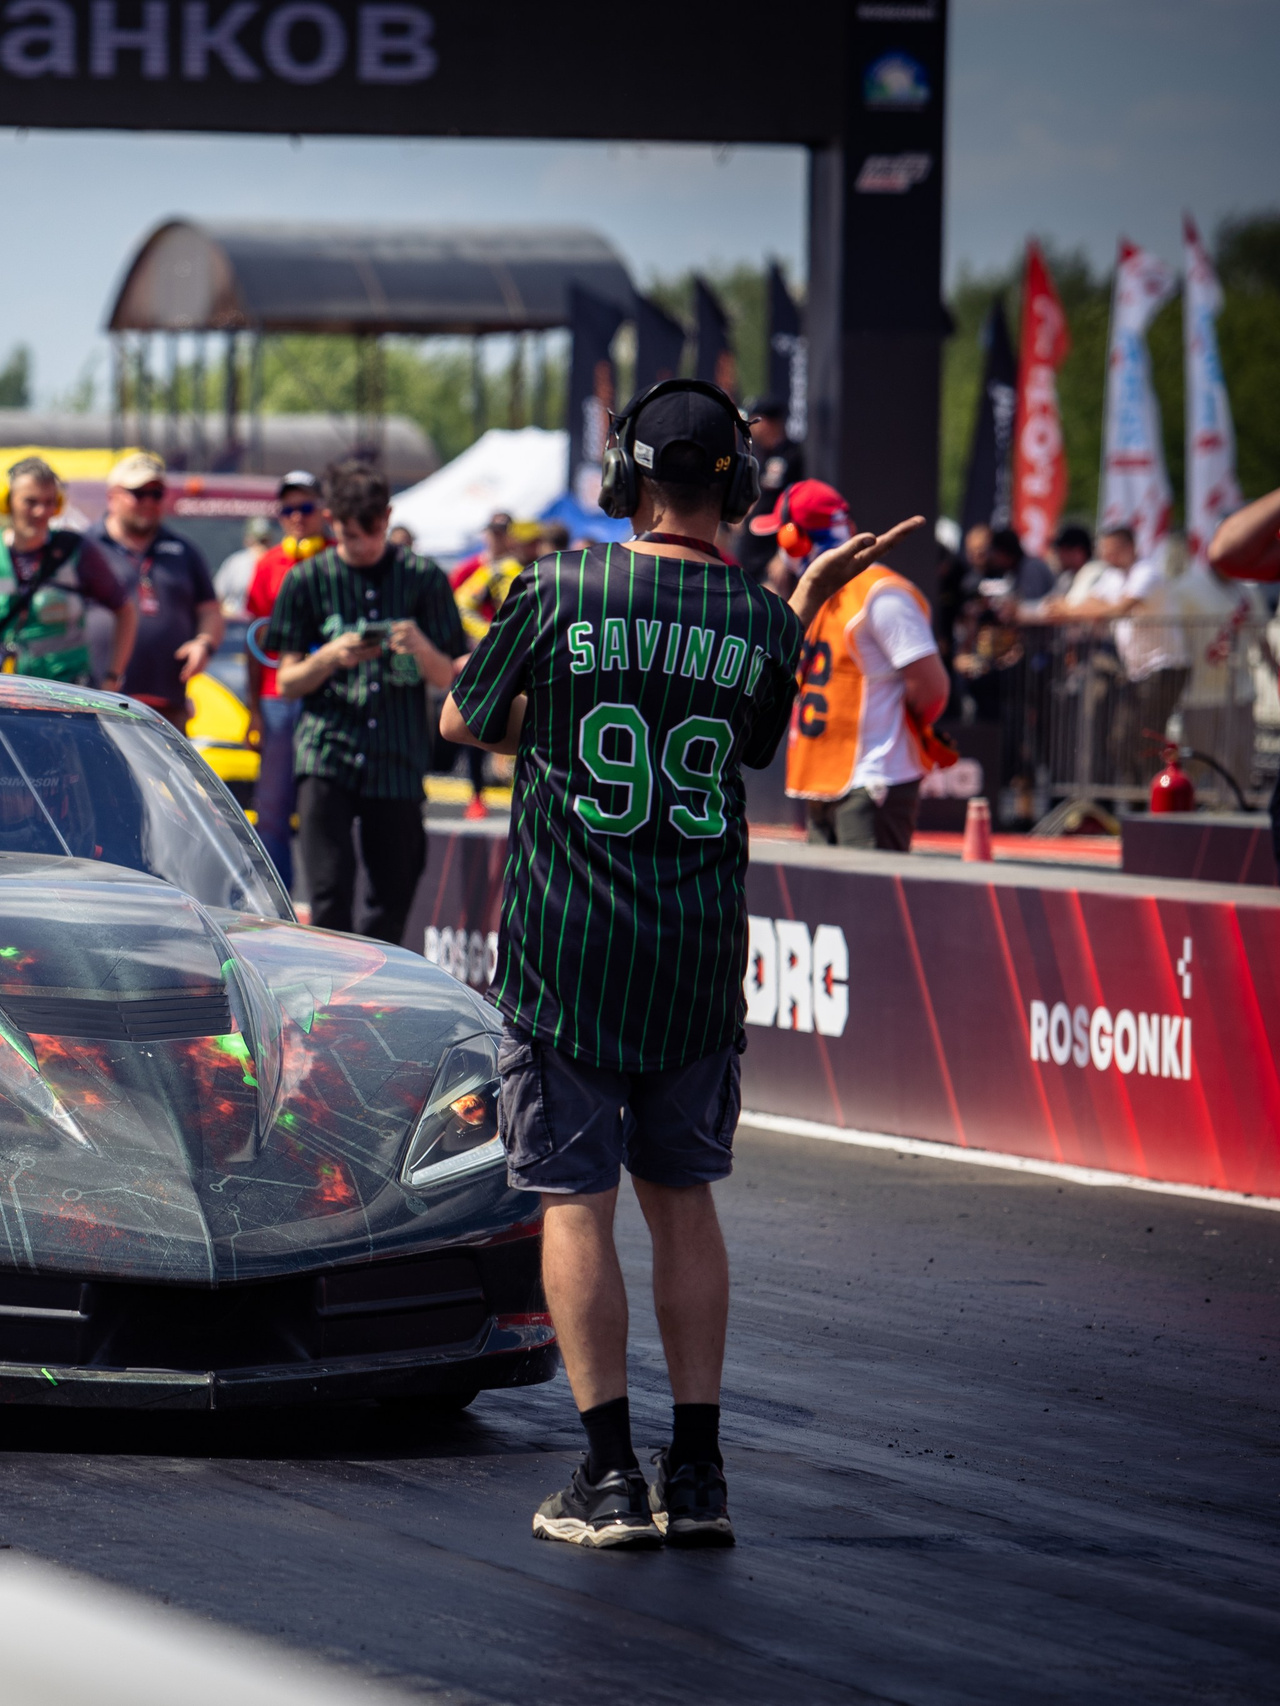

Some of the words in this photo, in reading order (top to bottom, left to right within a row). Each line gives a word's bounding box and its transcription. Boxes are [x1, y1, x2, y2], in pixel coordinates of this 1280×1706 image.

[715, 456, 731, 472] 99
[568, 618, 771, 696] SAVINOV
[573, 702, 734, 839] 99
[424, 926, 499, 986] ROSGO
[746, 914, 849, 1038] DRC
[1031, 1000, 1192, 1080] ROSGONKI
